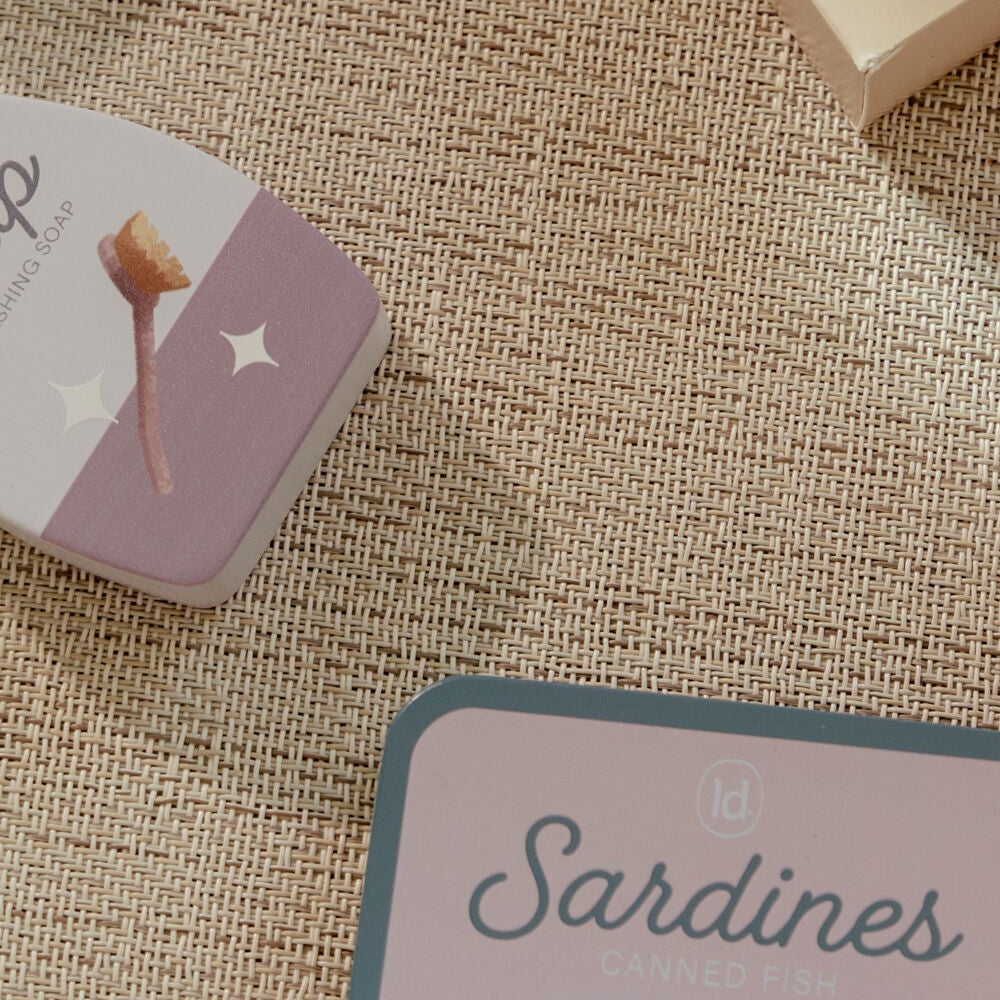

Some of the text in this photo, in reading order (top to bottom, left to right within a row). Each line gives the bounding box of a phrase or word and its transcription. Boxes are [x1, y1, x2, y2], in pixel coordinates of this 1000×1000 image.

[0, 200, 75, 328] SHING SOAP
[468, 814, 965, 962] Sardines
[601, 949, 838, 999] CANNED FISH
